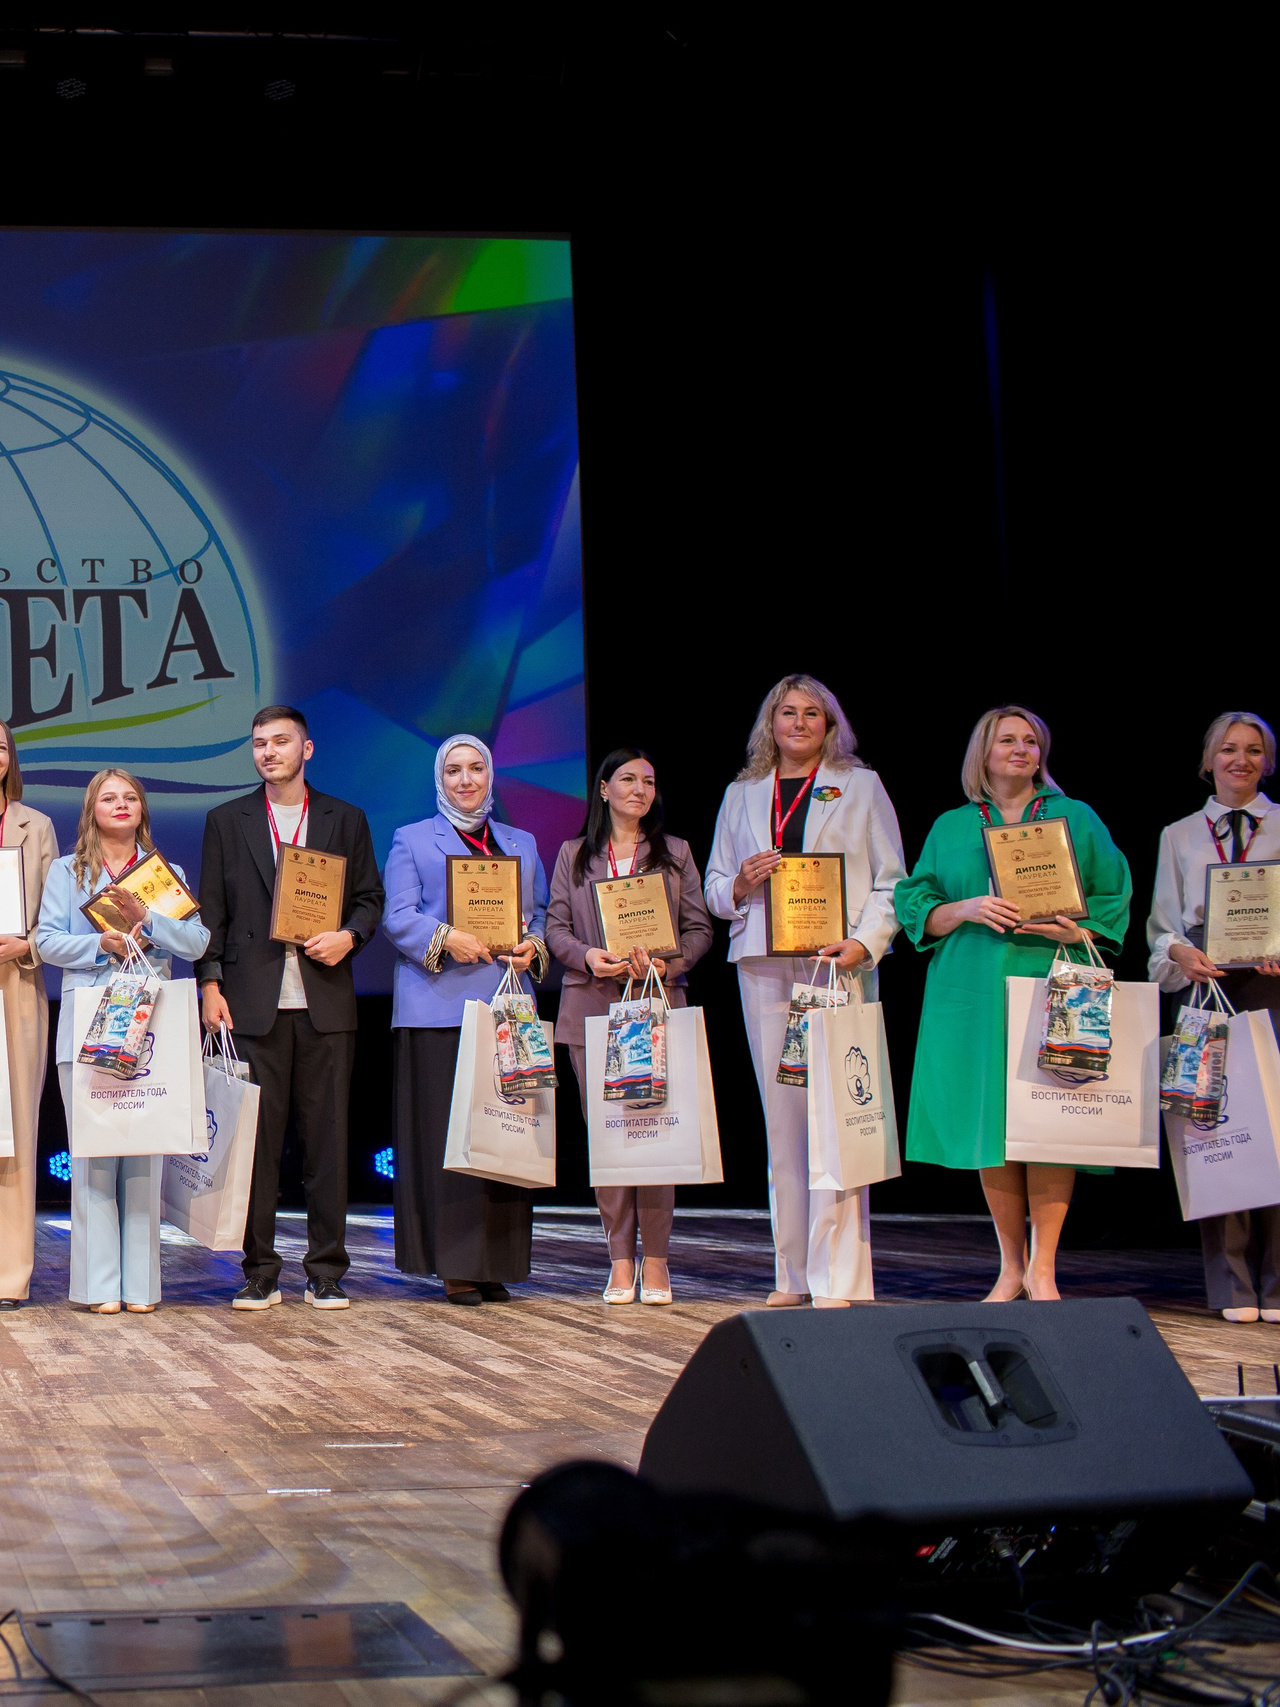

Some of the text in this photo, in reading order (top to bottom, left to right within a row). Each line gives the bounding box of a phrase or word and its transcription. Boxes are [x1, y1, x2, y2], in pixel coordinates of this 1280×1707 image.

[1015, 863, 1056, 875] ДИПЛОМ
[1016, 870, 1057, 881] ЛАУРЕАТА
[295, 888, 327, 901] ДИПЛОМ
[294, 896, 326, 907] ЛАУРЕАТА
[618, 908, 655, 920] ДИПЛОМ
[1226, 907, 1269, 916] ДИПЛОМ
[619, 915, 656, 925] ЛАУРЕАТА
[90, 1087, 167, 1100] ВОСПИТАТЕЛЬ ГОДА
[1031, 1091, 1133, 1105] ВОСПИТАТЕЛЬ ГОДА
[113, 1101, 144, 1110] РОССИИ
[1061, 1105, 1103, 1115] РОССИИ
[484, 1106, 525, 1123] ВОСПИТАТЕЛЬ
[524, 1116, 541, 1127] ГОДА
[605, 1116, 680, 1129] ВОСПИТАТЕЛЬ ГОДА
[501, 1122, 526, 1135] РОССИИ
[627, 1130, 658, 1139] РОССИИ
[1182, 1133, 1252, 1156] ВОСПИТАТЕЛЬ ГОДА
[1203, 1150, 1234, 1164] РОССИИ
[169, 1156, 200, 1180] ВОСПИТАТЕЛЬ
[200, 1174, 213, 1188] ГОДА
[179, 1175, 199, 1191] РОССИИ
